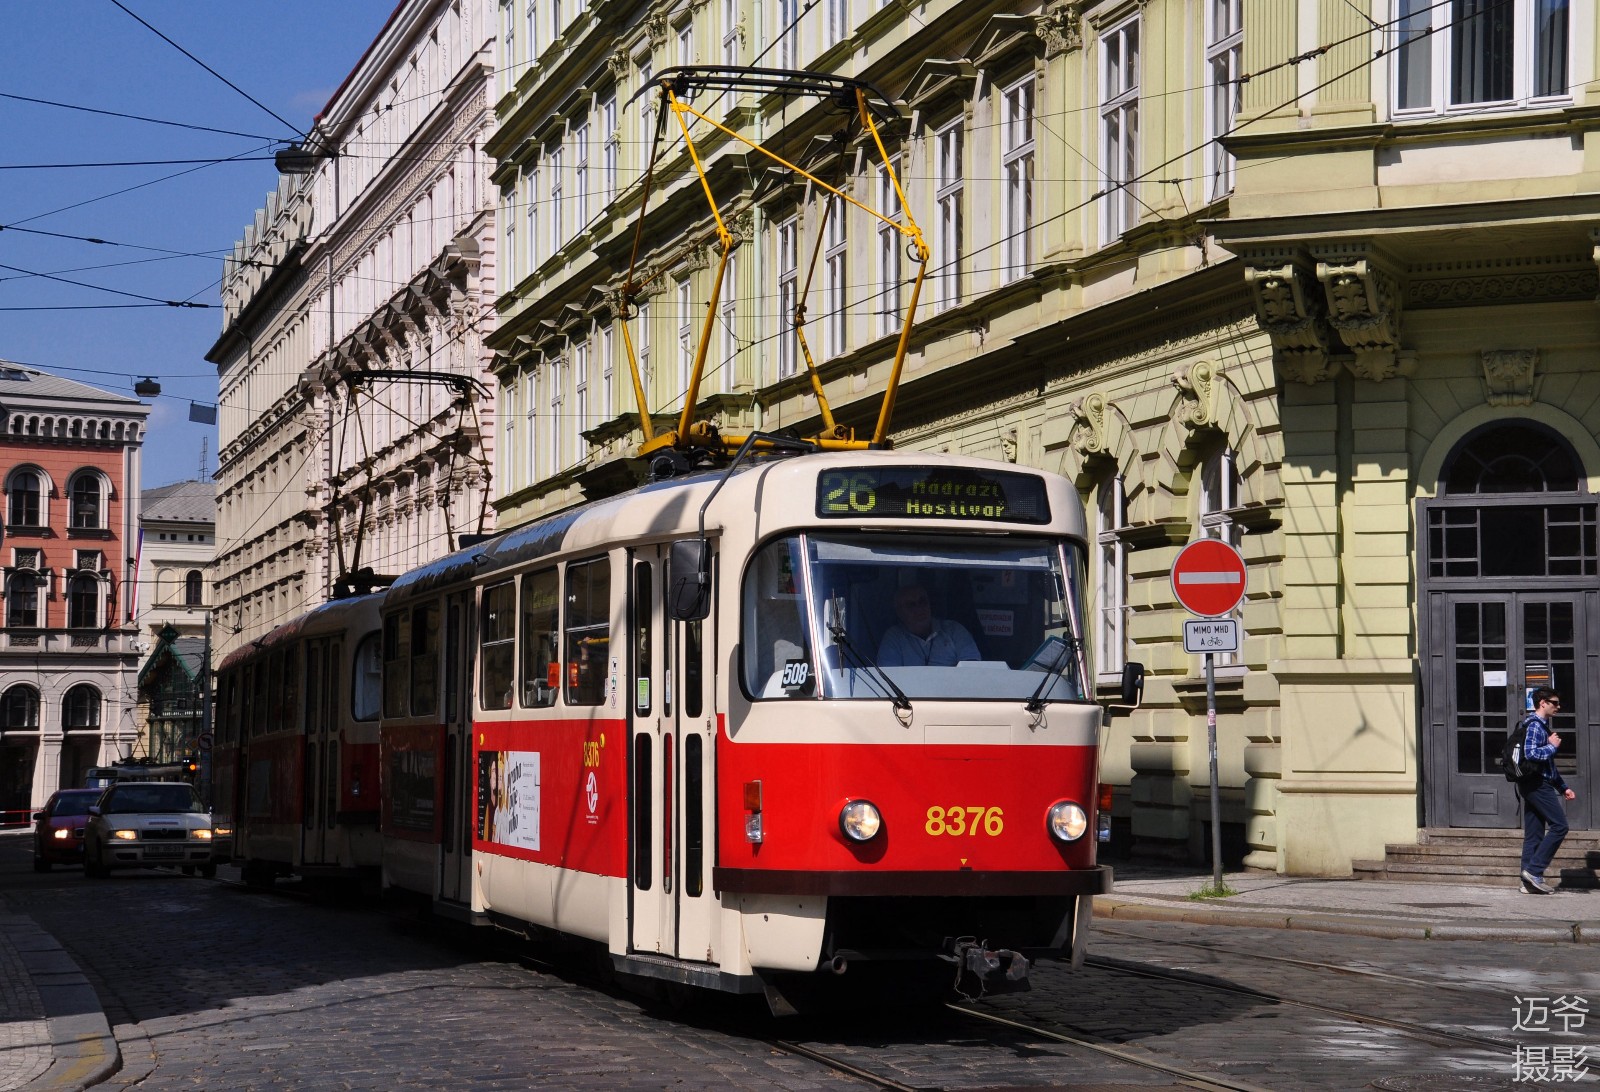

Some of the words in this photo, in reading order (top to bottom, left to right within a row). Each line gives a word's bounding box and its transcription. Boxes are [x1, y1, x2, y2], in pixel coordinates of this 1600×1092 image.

[823, 472, 876, 512] 26
[1193, 625, 1212, 635] MIMO
[1214, 625, 1229, 634] MHD
[782, 662, 808, 685] 508
[583, 741, 600, 768] 8376
[925, 805, 1004, 837] 8376
